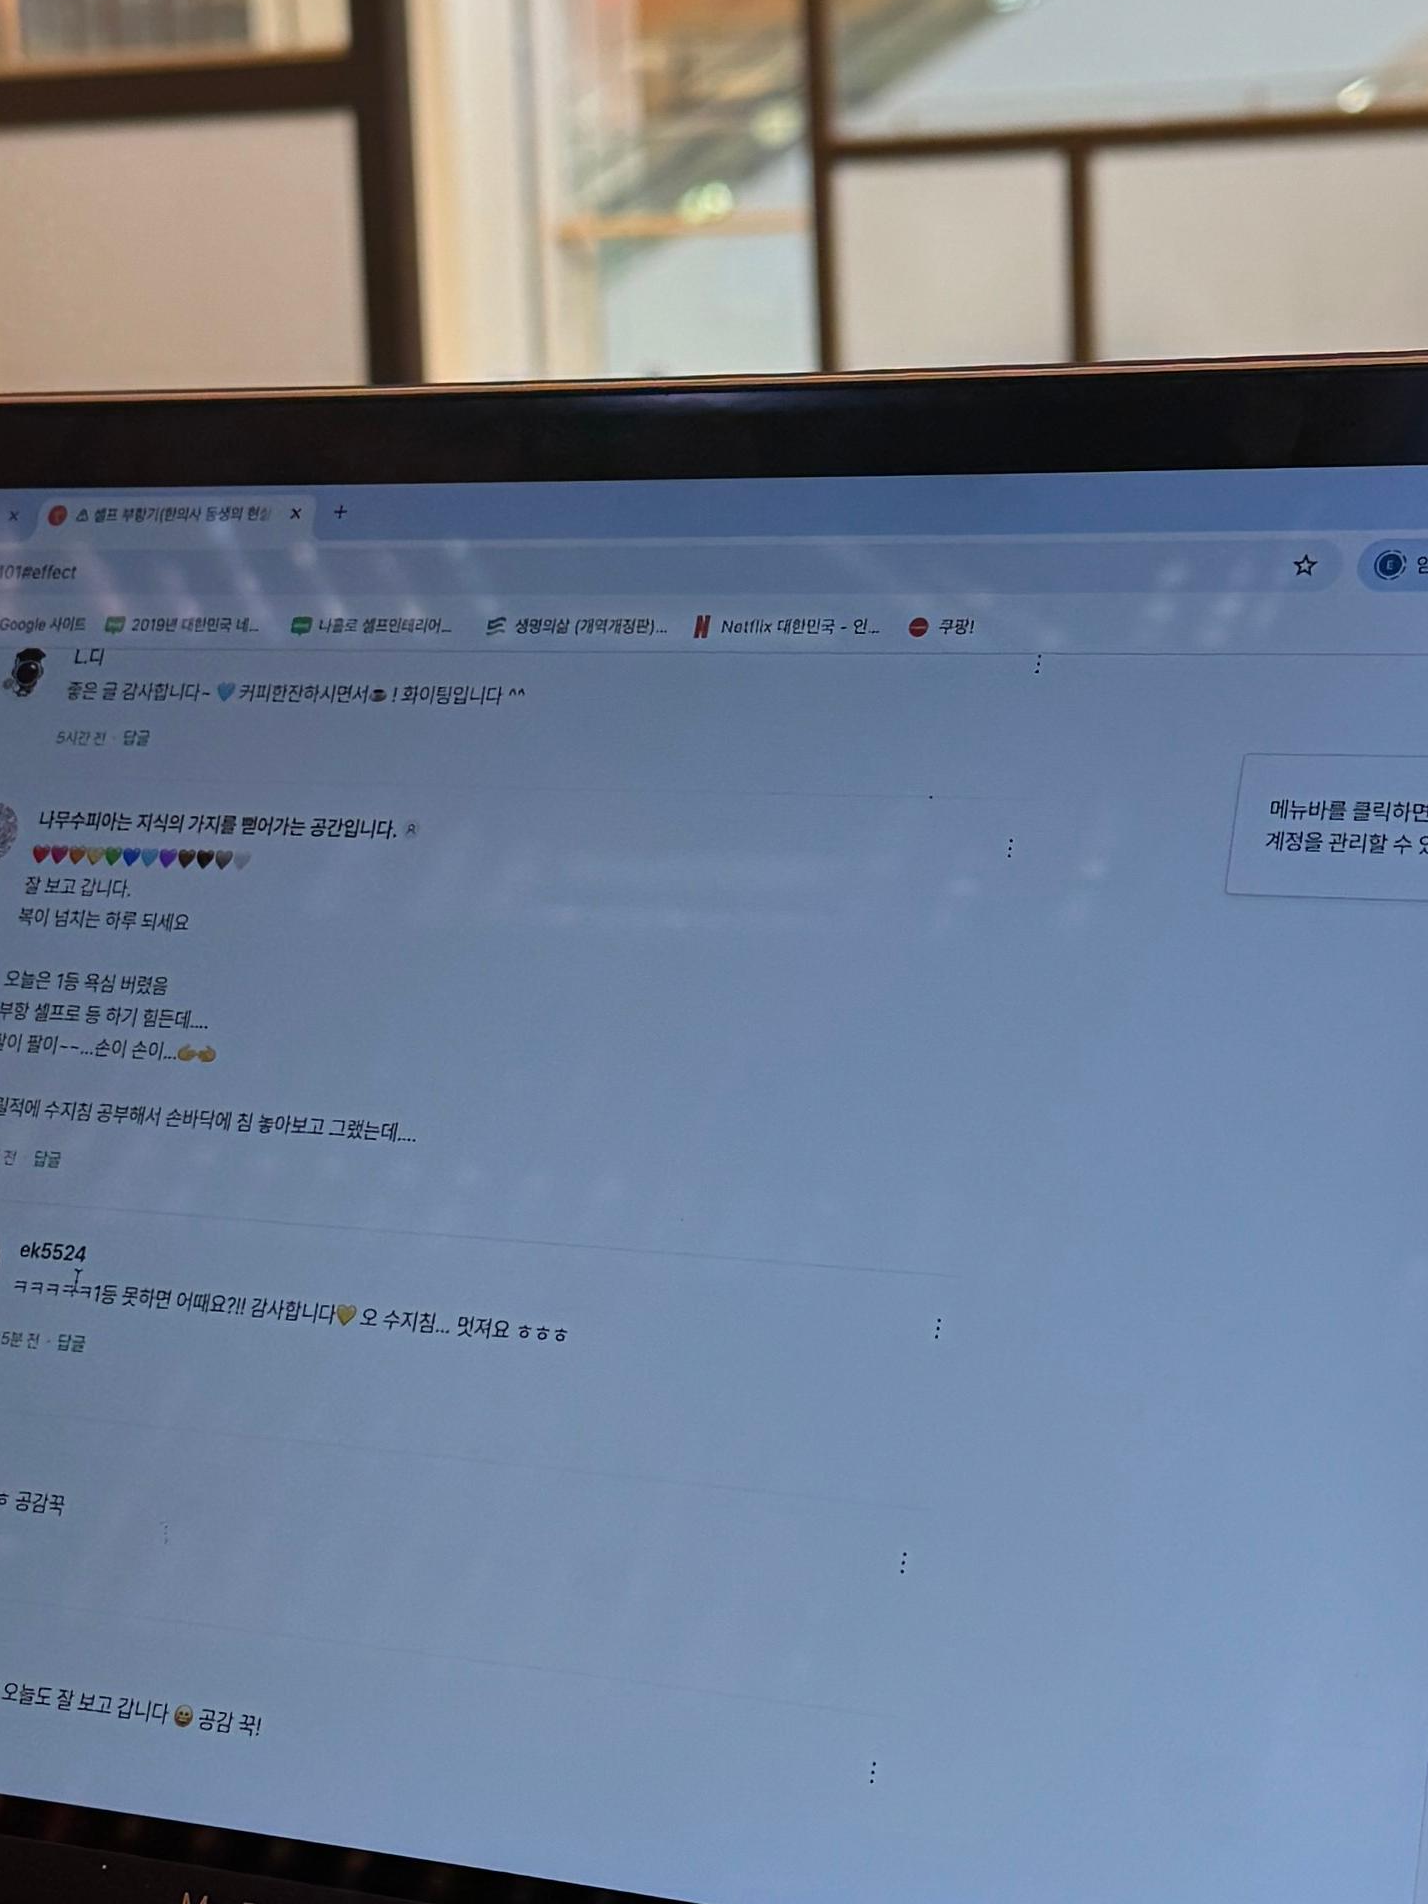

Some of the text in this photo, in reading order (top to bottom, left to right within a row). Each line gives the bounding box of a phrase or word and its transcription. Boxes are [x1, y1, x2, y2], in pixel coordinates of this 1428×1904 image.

[0, 615, 86, 634] Google 사이트
[131, 616, 177, 633] 2019년
[181, 616, 233, 634] 대한민국
[319, 616, 358, 634] 나홀로
[721, 618, 772, 635] Netflix
[776, 617, 835, 637] 대한민국
[938, 617, 974, 636] 쿠팡!
[67, 681, 97, 701] 좋은
[101, 682, 118, 701] 글
[239, 684, 369, 704] 커피한잔하시면서
[400, 686, 502, 706] 화이팅입니다
[55, 730, 151, 747] 5시간 전 답글
[1269, 798, 1347, 822] 메뉴바를
[38, 809, 133, 833] 나무수피아는
[136, 812, 184, 835] 지식의
[187, 813, 237, 836] 가지를
[310, 817, 397, 840] 공간입니다.
[1265, 830, 1322, 854] 계정을
[1327, 832, 1389, 856] 관리할
[1392, 833, 1413, 856] 수
[25, 876, 131, 898] 잘 보고 갑니다.
[18, 907, 189, 932] 복이 넘치는 하루 되세요
[4, 969, 168, 997] 오늘은 1등 욕심 버렸음
[33, 1002, 81, 1024] 셀프로
[105, 1006, 138, 1028] 하기
[44, 1099, 92, 1123] 수지침
[97, 1102, 163, 1128] 공부해서
[165, 1106, 232, 1133] 손바닥에
[236, 1111, 253, 1134] 침
[257, 1113, 324, 1137] 놓아보고
[3, 1148, 17, 1166] 전
[34, 1149, 62, 1169] 답글
[19, 1240, 87, 1263] ek5524
[122, 1285, 172, 1311] 못하면
[251, 1296, 336, 1327] 감사합니다
[359, 1307, 378, 1328] 오
[457, 1313, 511, 1341] 멋져요
[0, 1330, 87, 1354] 5분 전 답글
[15, 1491, 66, 1517] 공감꾹
[0, 1680, 53, 1709] 오늘도
[57, 1687, 75, 1712] 잘
[78, 1691, 113, 1717] 보고
[117, 1696, 170, 1726] 갑니다
[198, 1707, 236, 1735] 공감
[238, 1712, 263, 1739] 꾹!
